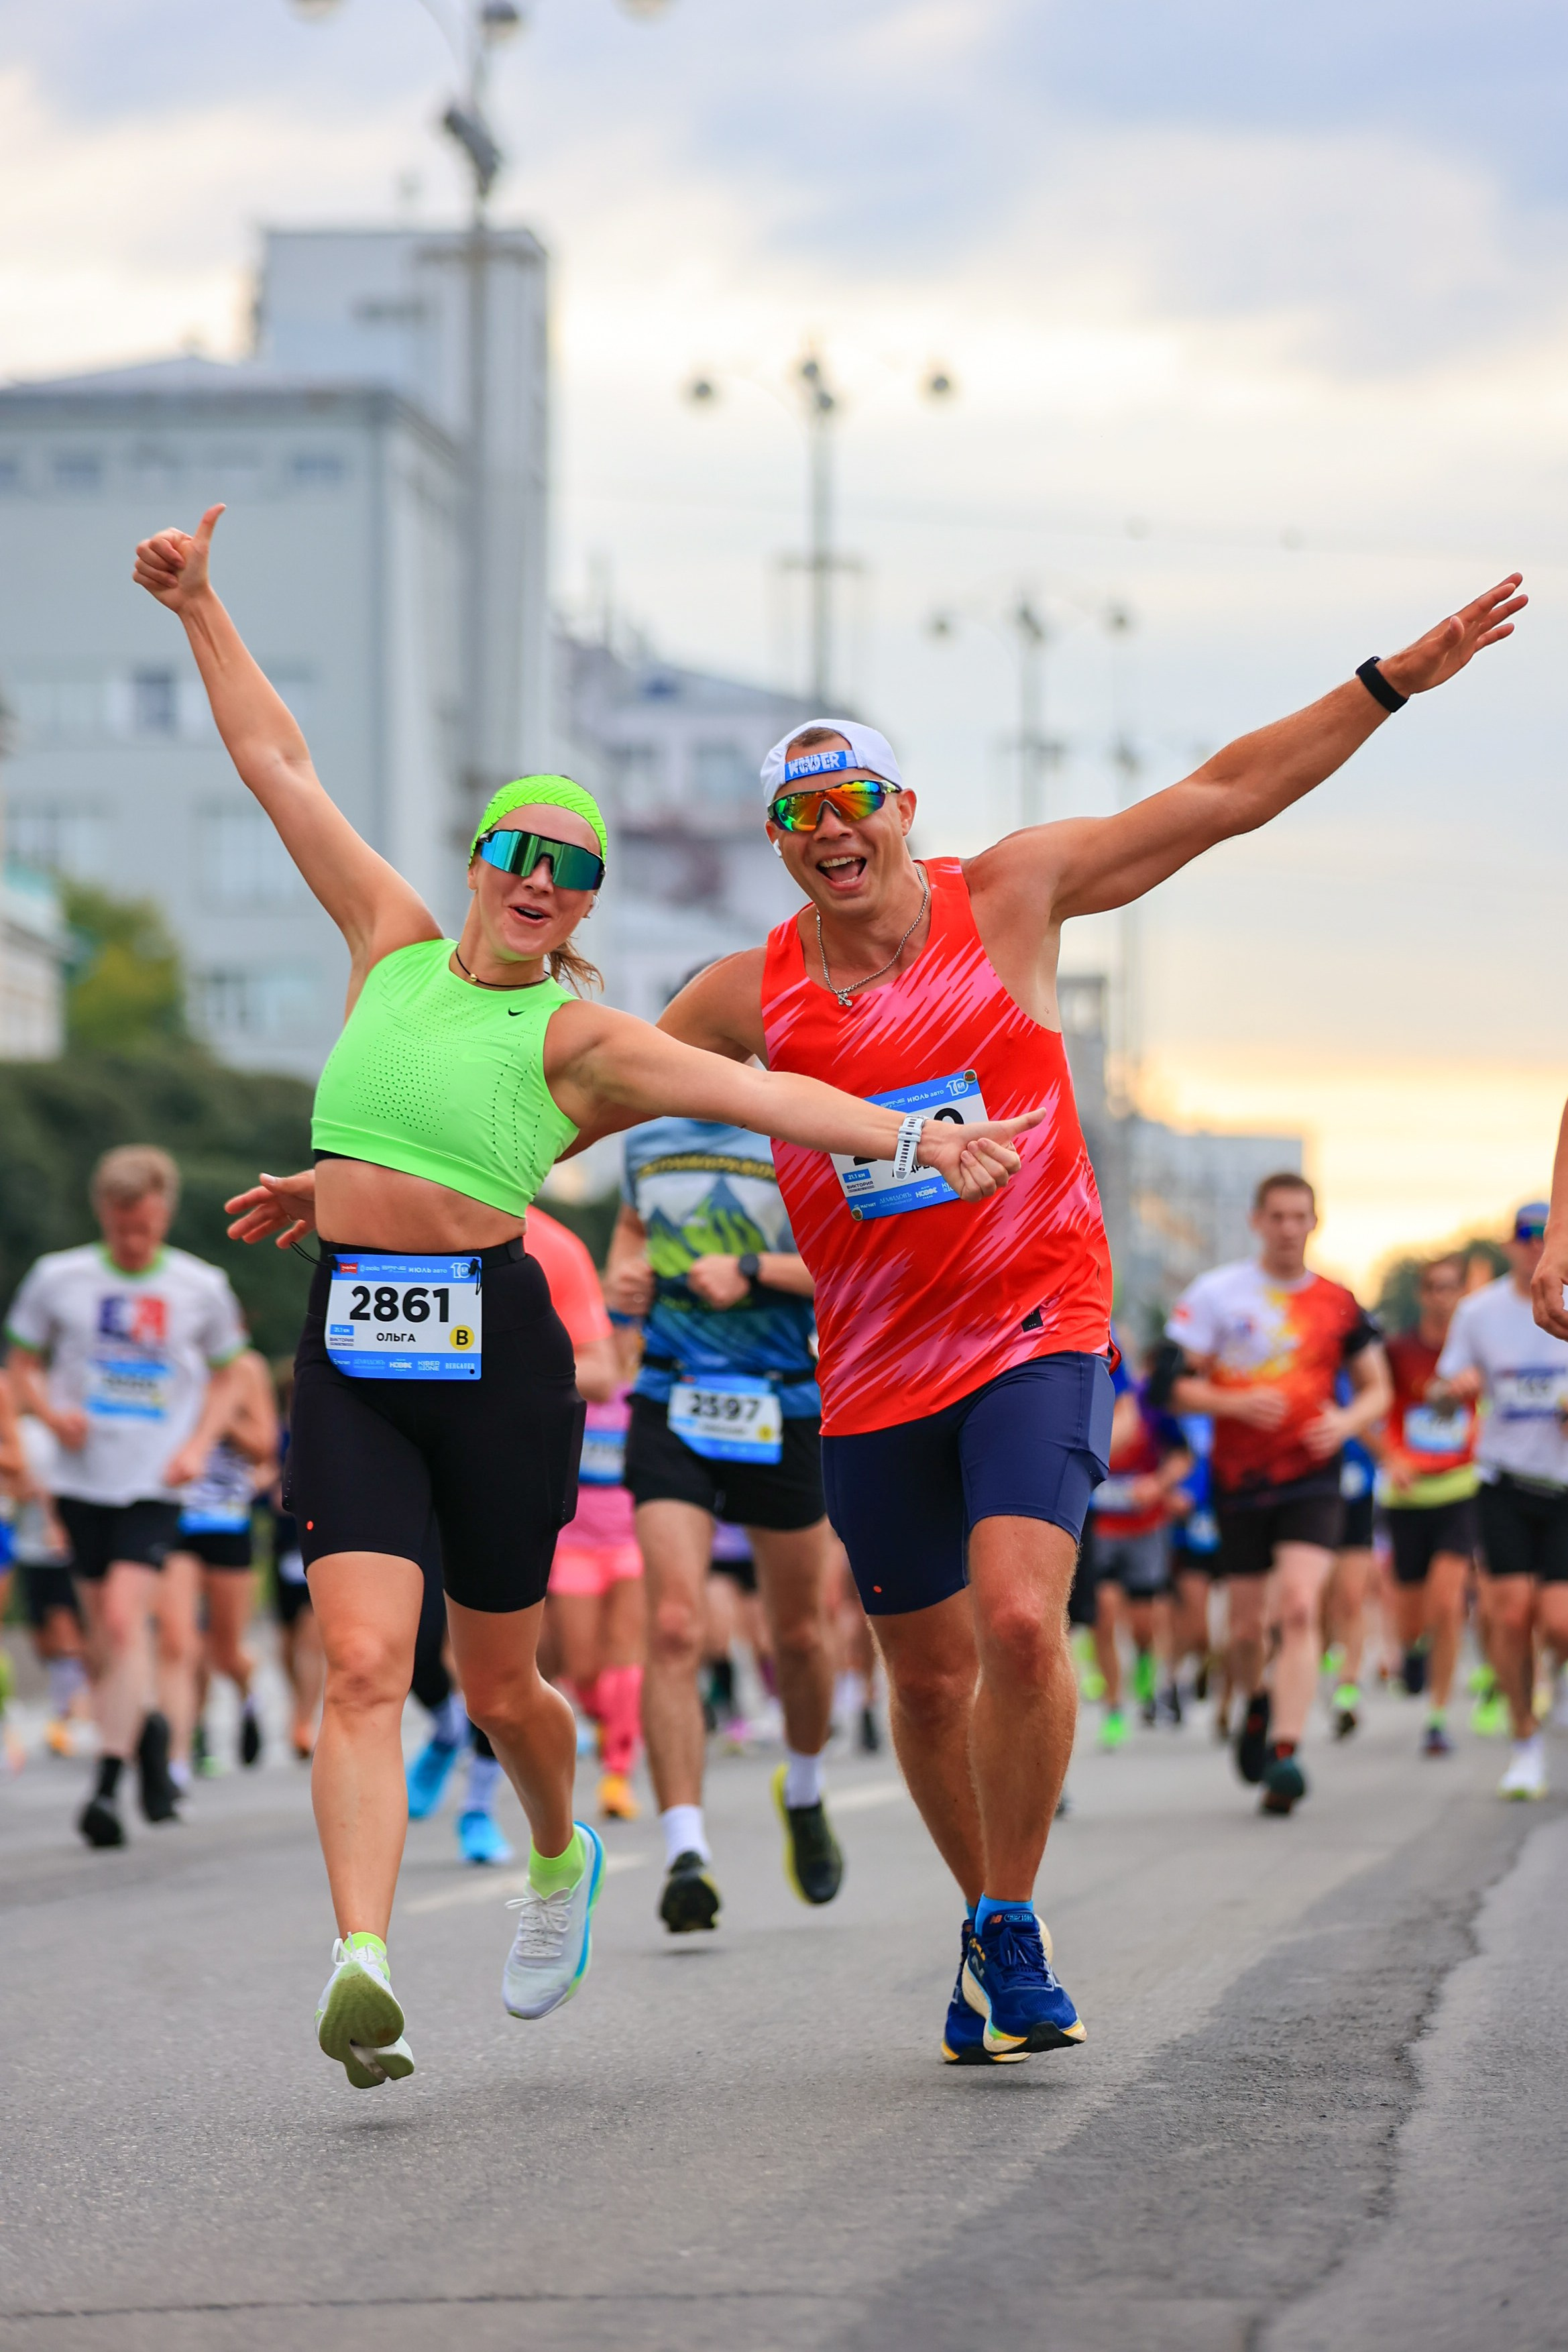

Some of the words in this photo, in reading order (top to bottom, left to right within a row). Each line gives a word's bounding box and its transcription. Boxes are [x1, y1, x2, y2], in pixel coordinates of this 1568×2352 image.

[907, 1093, 929, 1103] ИЮЛЬ
[930, 1089, 944, 1097] авто
[846, 1180, 874, 1190] ВИКТОРИЯ
[349, 1286, 449, 1323] 2861
[376, 1333, 416, 1343] ОЛЬГА
